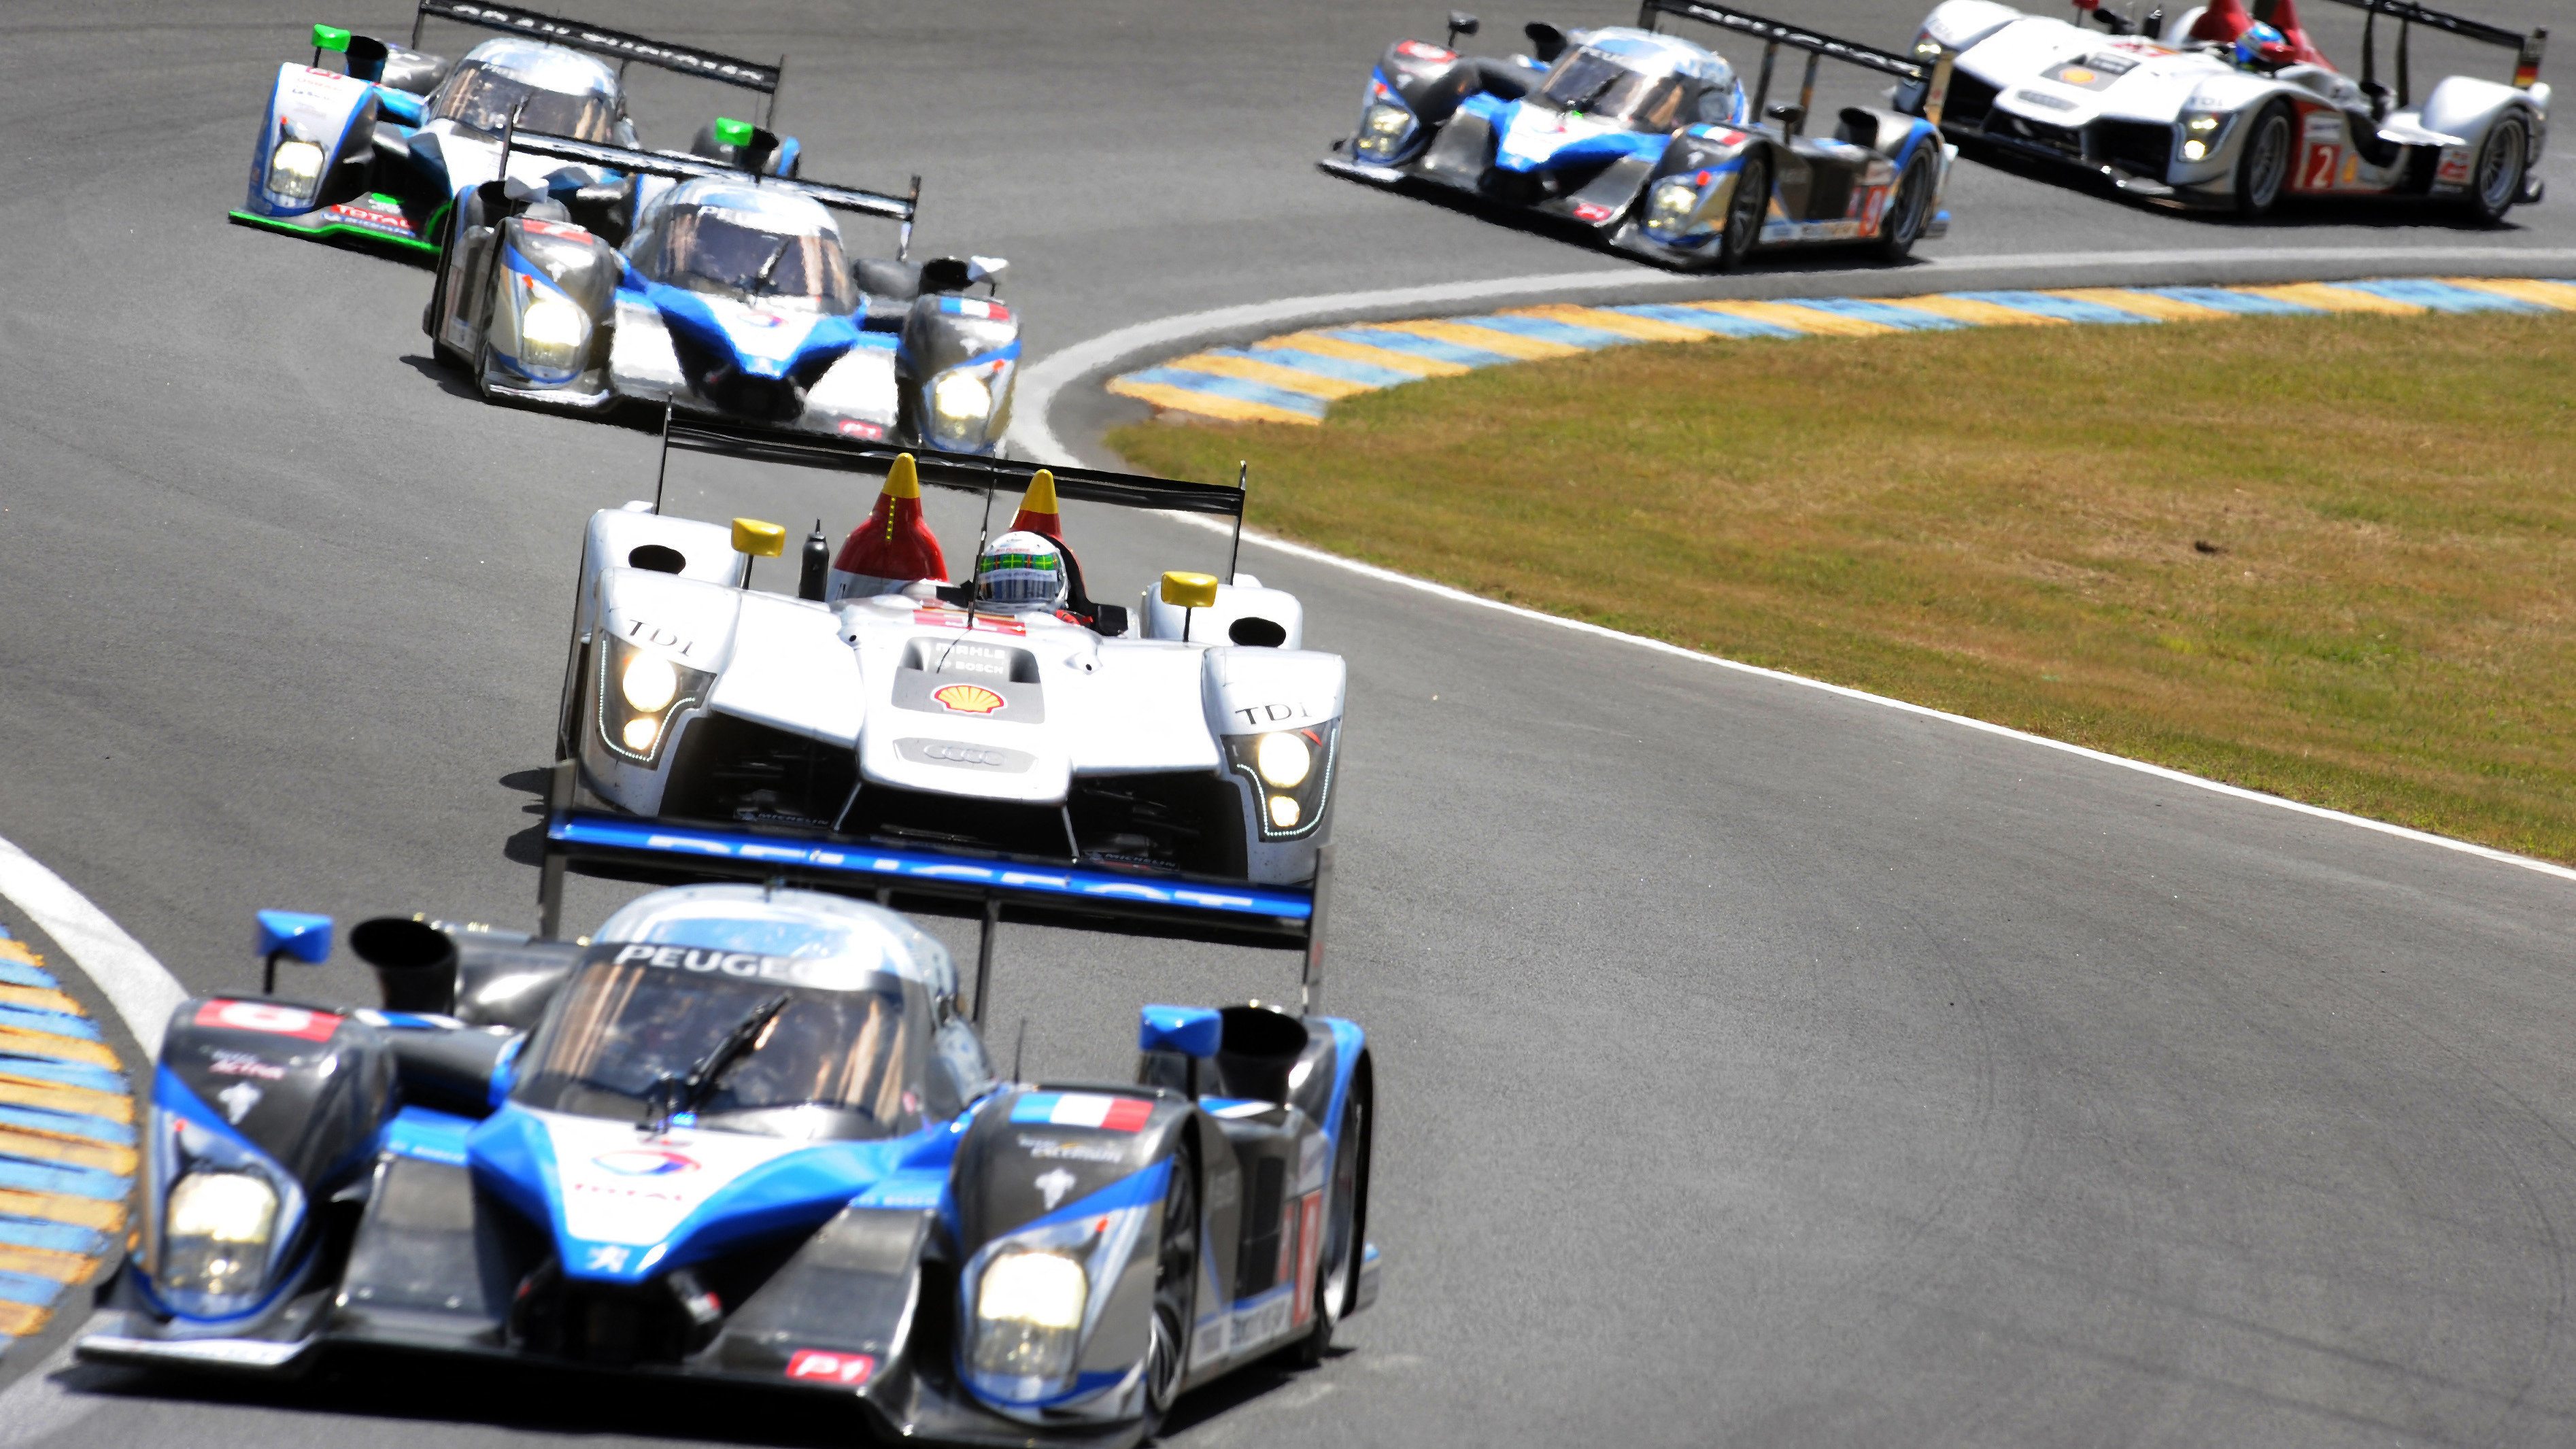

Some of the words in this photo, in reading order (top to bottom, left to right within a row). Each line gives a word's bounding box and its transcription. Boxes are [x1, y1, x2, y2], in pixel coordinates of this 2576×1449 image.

[2312, 146, 2334, 188] 2
[629, 619, 693, 658] TDI
[935, 643, 1006, 660] MAHLE
[955, 660, 1004, 674] BOSCH
[1234, 702, 1312, 725] TDI
[794, 1353, 865, 1382] P1
